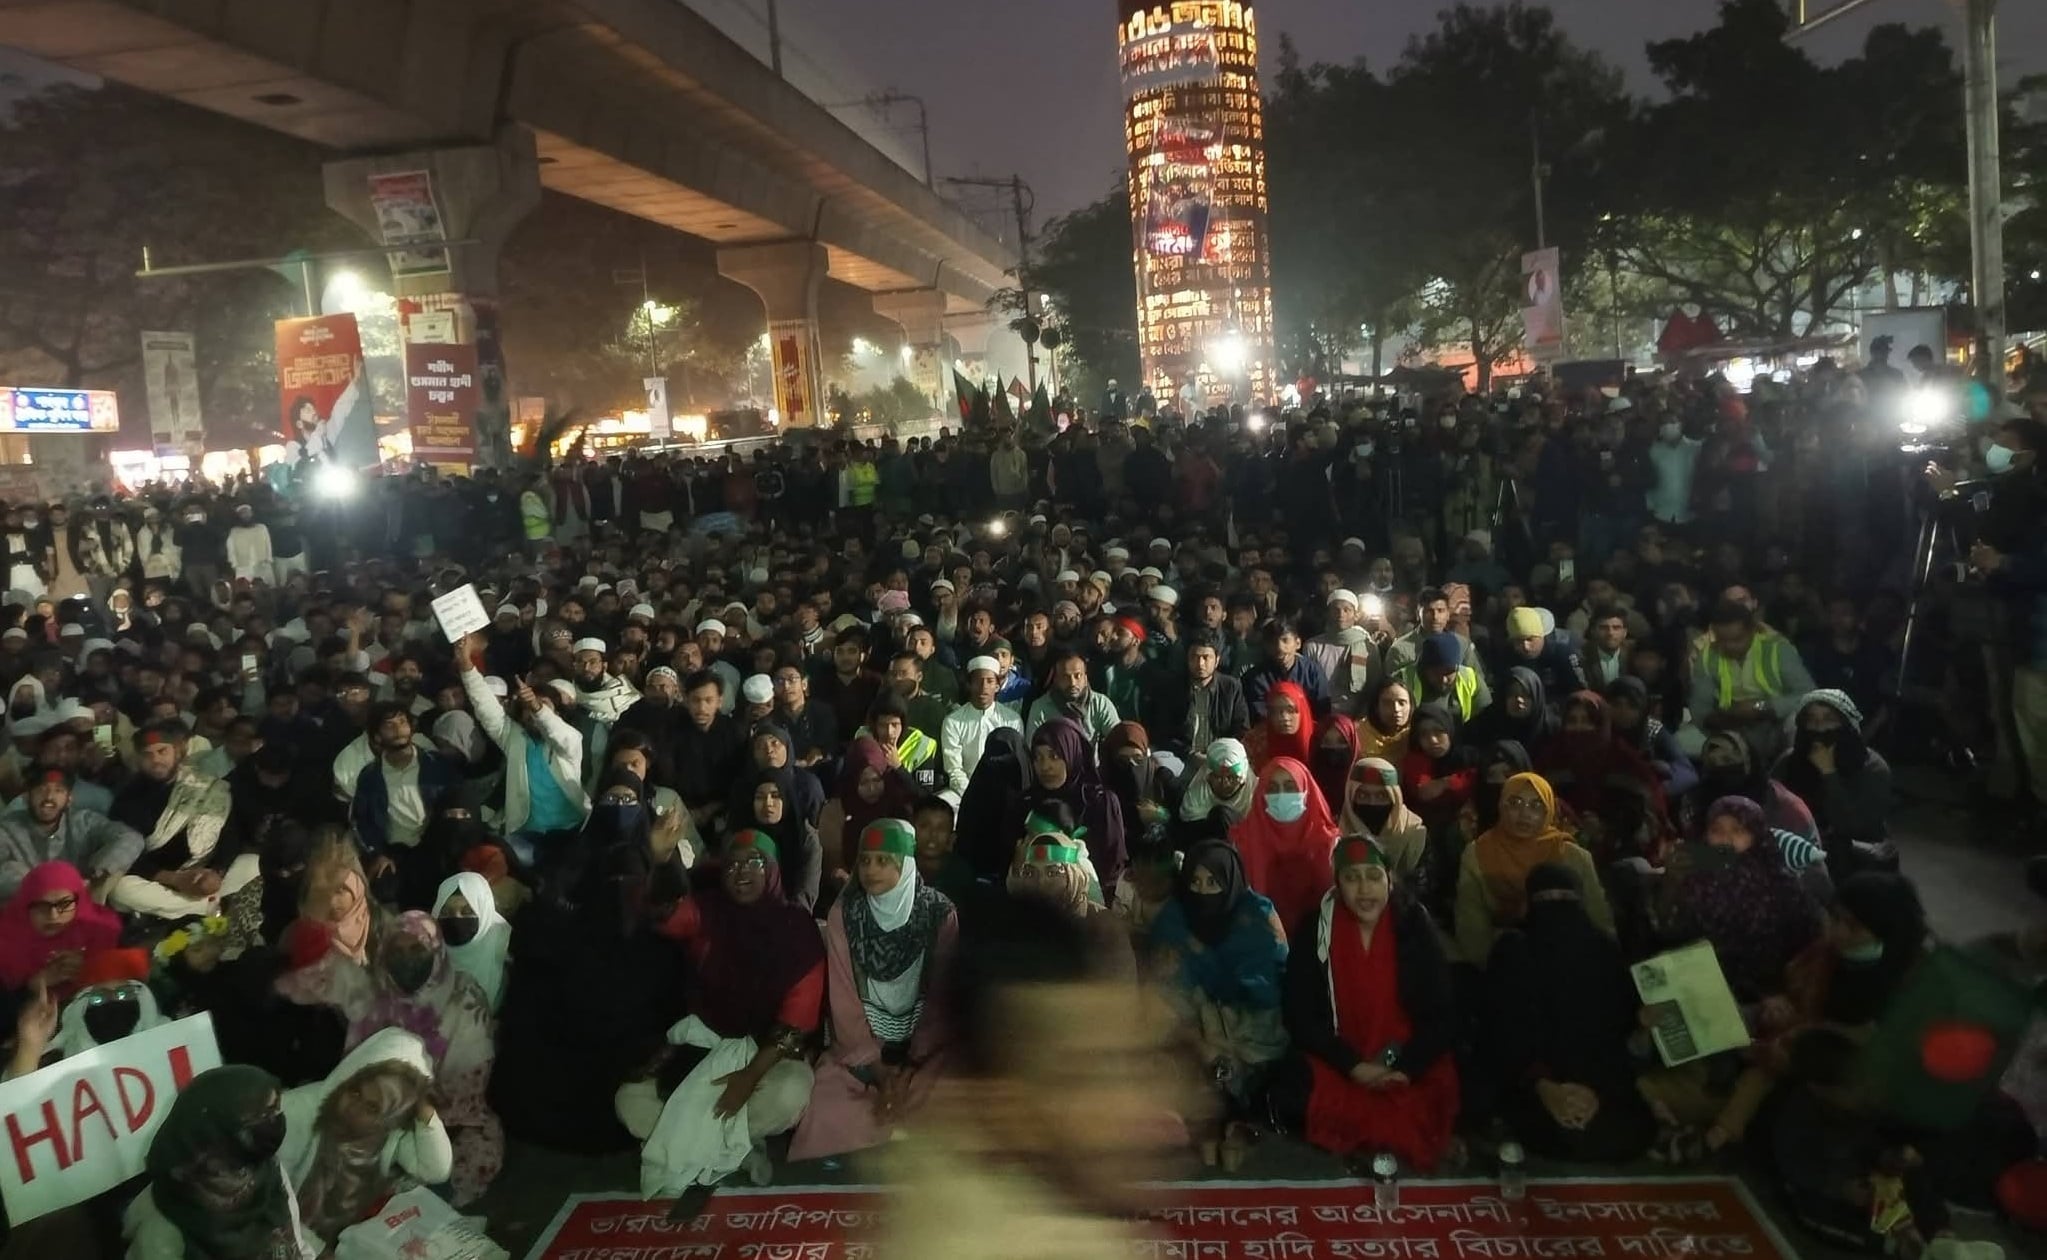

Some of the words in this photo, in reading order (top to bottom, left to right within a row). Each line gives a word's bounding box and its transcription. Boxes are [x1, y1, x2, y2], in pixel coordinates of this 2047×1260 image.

[5, 1045, 195, 1184] HADI
[1240, 1232, 1316, 1260] হাদি
[1449, 1229, 1606, 1260] বিচারের
